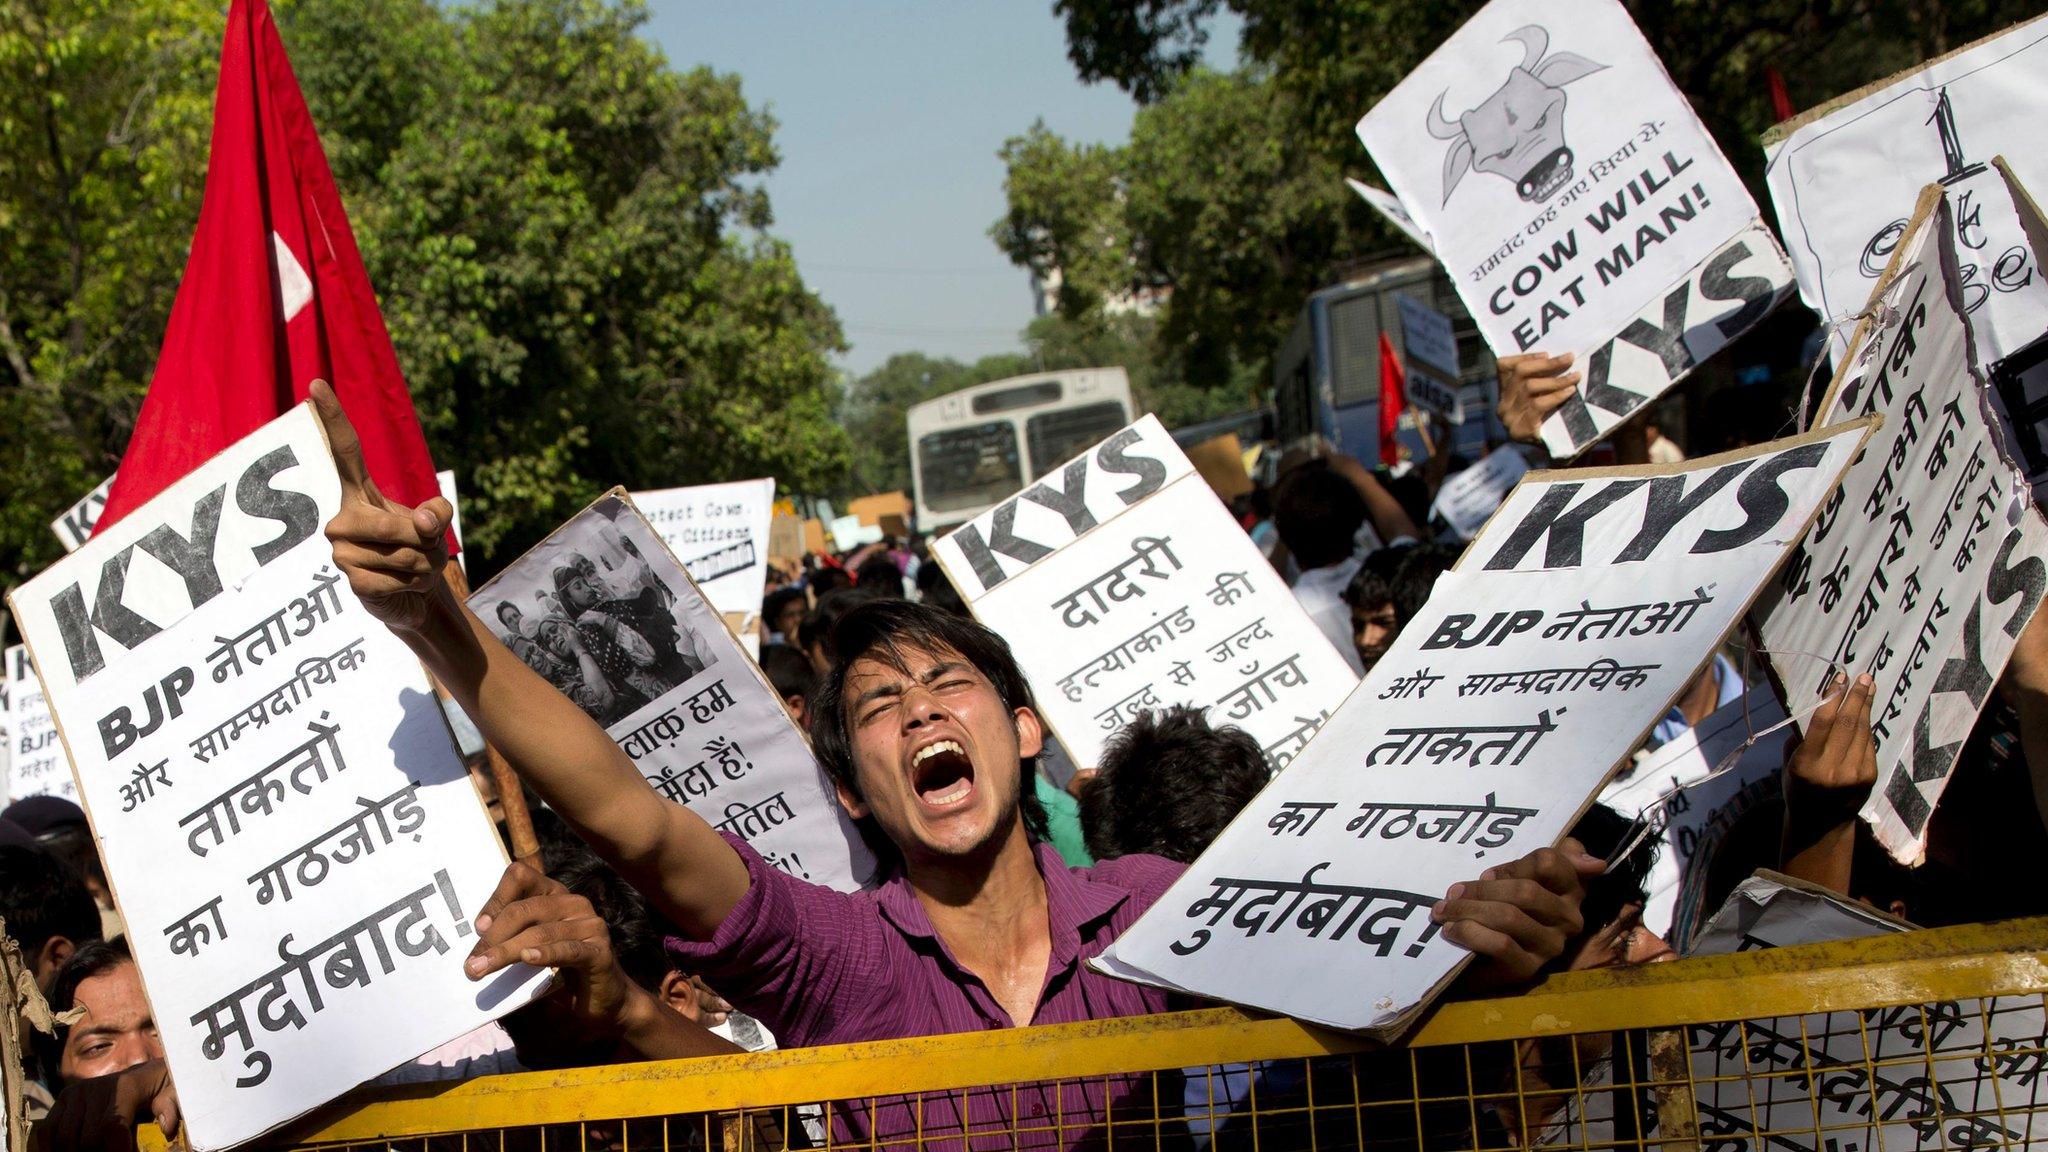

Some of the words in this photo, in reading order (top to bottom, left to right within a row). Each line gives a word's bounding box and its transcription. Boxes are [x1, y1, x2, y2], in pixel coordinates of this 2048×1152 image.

[1489, 228, 1578, 316] COW
[1585, 151, 1694, 234] WILL
[1511, 275, 1586, 353] EAT
[1594, 182, 1712, 287] MAN!
[1525, 205, 1558, 236] कह
[1560, 241, 1775, 450] KYS
[1818, 545, 1850, 614] के
[1863, 382, 1928, 522] सभी
[1925, 391, 1966, 481] को
[49, 444, 320, 686] KYS
[646, 505, 694, 523] otect
[952, 429, 1167, 591] KYS
[1483, 440, 1830, 571] KYS
[1899, 565, 1922, 615] से
[1930, 439, 1986, 551] जल्द
[1953, 475, 2003, 573] करो!
[1051, 535, 1183, 629] दादरी
[1055, 604, 1196, 703] हत्याकांड
[1206, 570, 1256, 607] की
[1419, 609, 1544, 650] BJP
[1541, 581, 1718, 643] नेताओं
[97, 666, 195, 761] BJP
[206, 564, 344, 684] नेताओं
[681, 678, 737, 724] हम
[1167, 660, 1196, 686] से
[1206, 617, 1274, 664] जल्द
[1216, 653, 1309, 720] जाँच
[1378, 666, 1445, 700] और
[1458, 658, 1662, 696] साम्प्रदायिक
[1884, 527, 2047, 841] KYS
[118, 757, 173, 813] और
[189, 636, 366, 763] साम्प्रदायिक
[178, 709, 347, 858] ताकतों
[1365, 706, 1567, 768] ताकतों
[162, 895, 228, 958] का
[247, 780, 427, 907] गठजोड़
[1268, 801, 1338, 837] का
[1345, 791, 1541, 860] गठजोड़
[1168, 861, 1446, 960] मुर्दाबाद!
[191, 867, 474, 1089] मुर्दाबाद!
